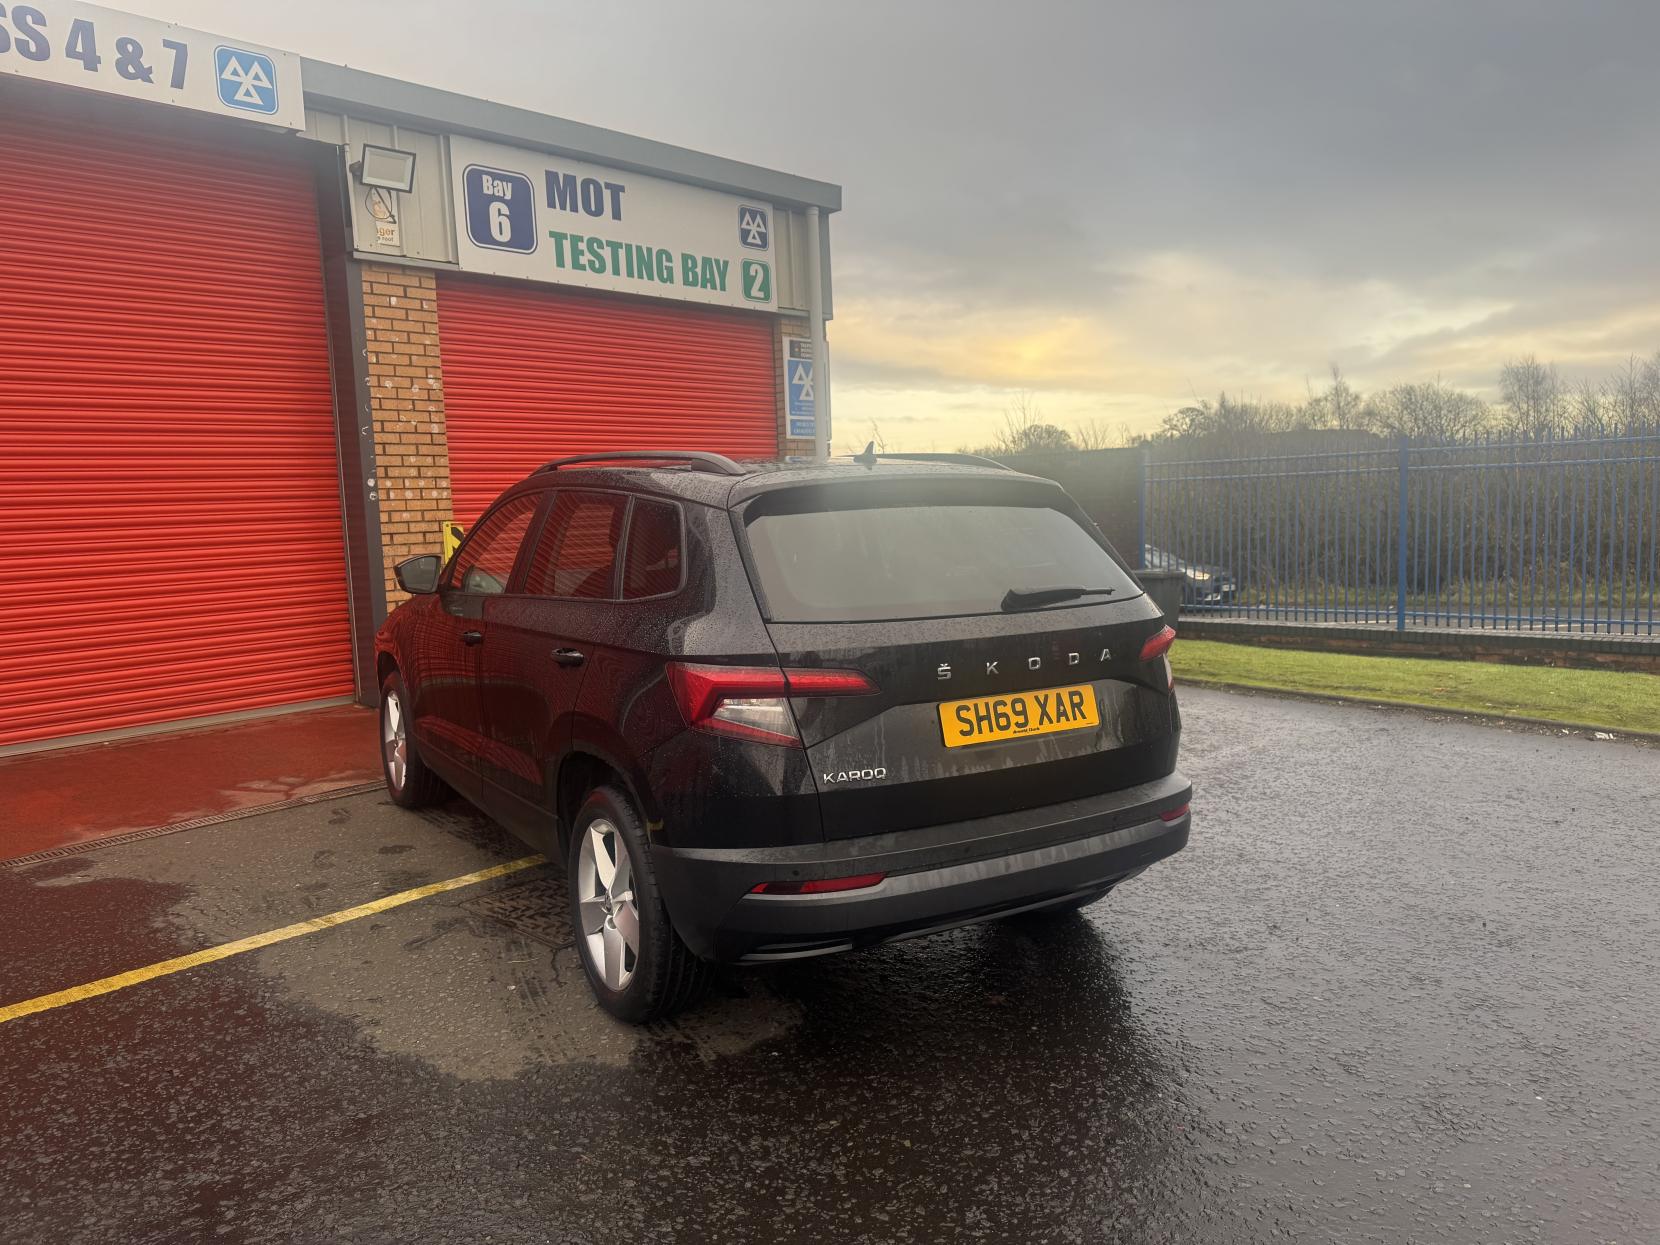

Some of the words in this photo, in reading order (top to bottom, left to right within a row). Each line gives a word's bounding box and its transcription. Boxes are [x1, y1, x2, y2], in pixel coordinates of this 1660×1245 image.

[0, 4, 50, 61] S
[65, 18, 101, 72] 4
[115, 37, 154, 84] &
[162, 39, 188, 89] 7
[482, 175, 512, 199] Bay
[545, 170, 625, 221] MOT
[489, 201, 511, 242] 6
[549, 230, 674, 284] TESTING
[681, 253, 729, 292] BAY
[750, 263, 765, 298] 2
[937, 649, 1111, 680] ŠKODA
[955, 698, 1029, 737] SH69
[1034, 690, 1087, 726] XAR
[823, 767, 886, 784] KAROQ
